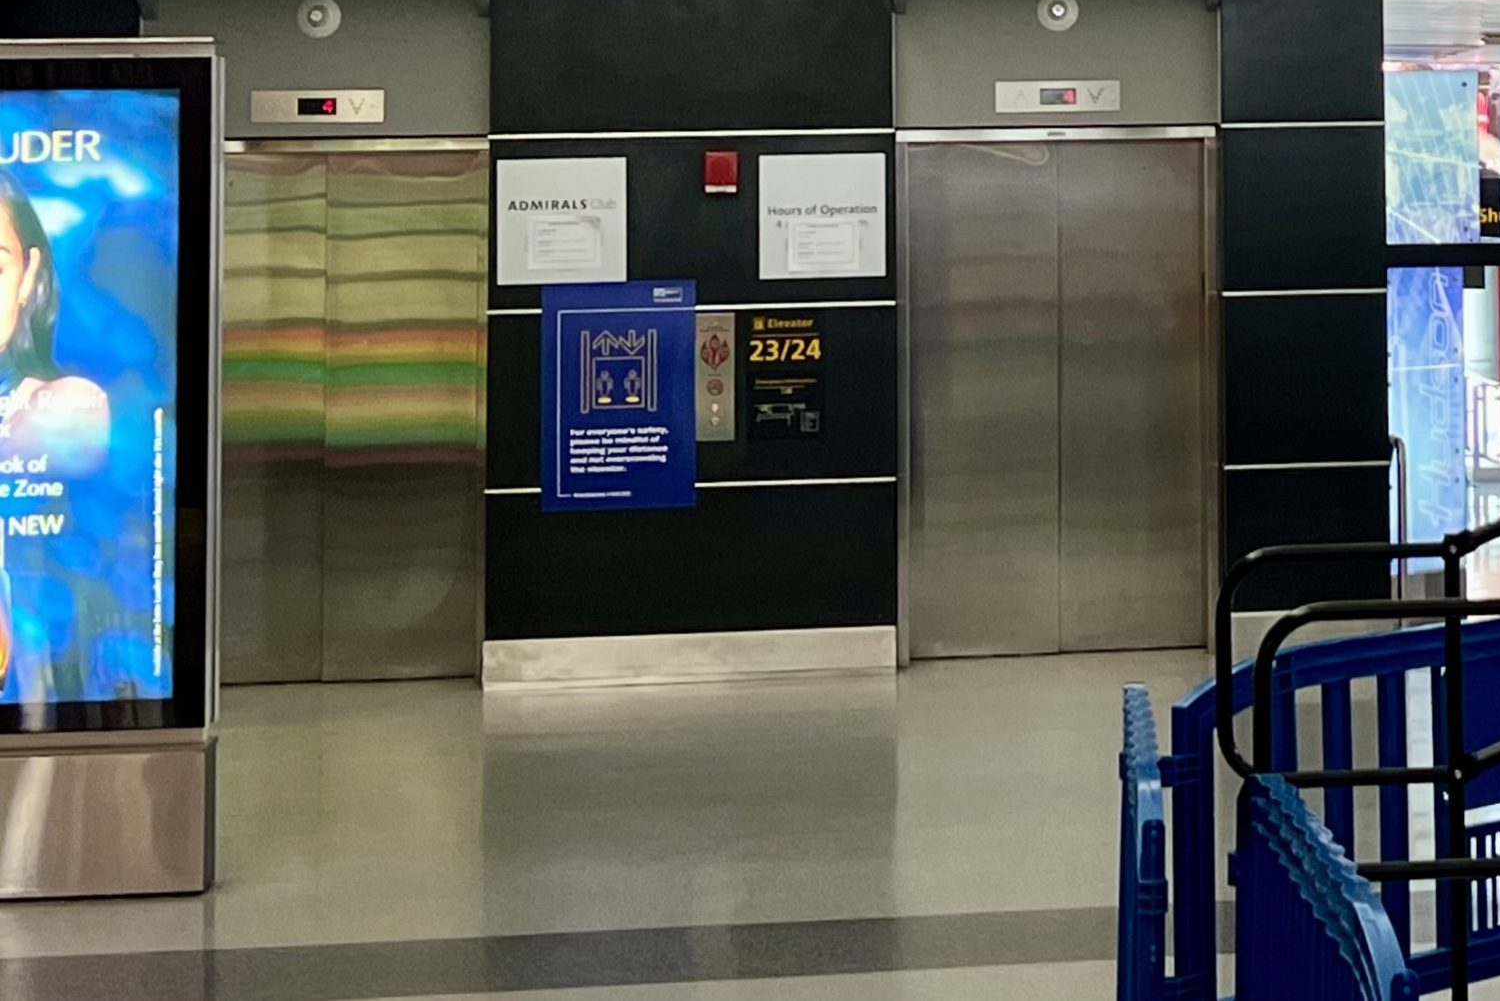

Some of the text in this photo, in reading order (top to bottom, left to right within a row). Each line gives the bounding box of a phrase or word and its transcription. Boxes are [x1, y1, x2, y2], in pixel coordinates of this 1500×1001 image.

[507, 199, 588, 211] ADMIRALS
[767, 204, 878, 218] Hours of Operation
[767, 318, 814, 329] Elevator
[748, 338, 822, 362] 23/24
[1416, 272, 1452, 525] Hudson
[27, 454, 48, 474] of
[13, 479, 64, 498] Zone
[8, 513, 65, 537] NEW
